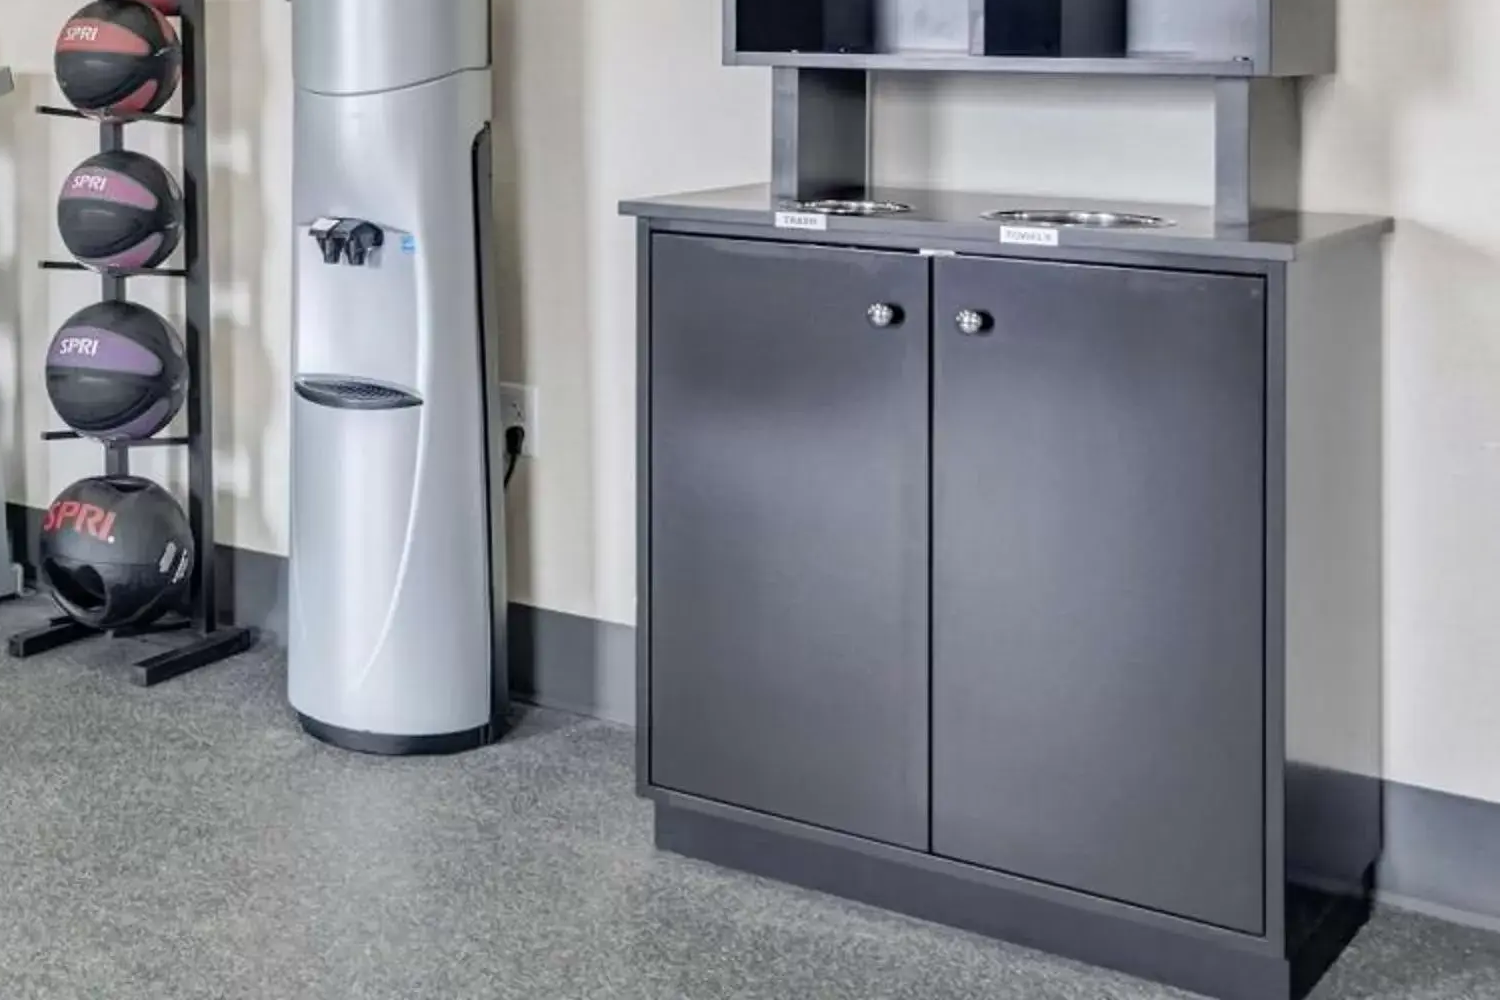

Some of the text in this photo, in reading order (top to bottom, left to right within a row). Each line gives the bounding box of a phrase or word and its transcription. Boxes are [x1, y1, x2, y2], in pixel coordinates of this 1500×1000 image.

[63, 25, 99, 41] SPRI
[71, 174, 107, 192] SPRI
[59, 336, 100, 357] SPRI
